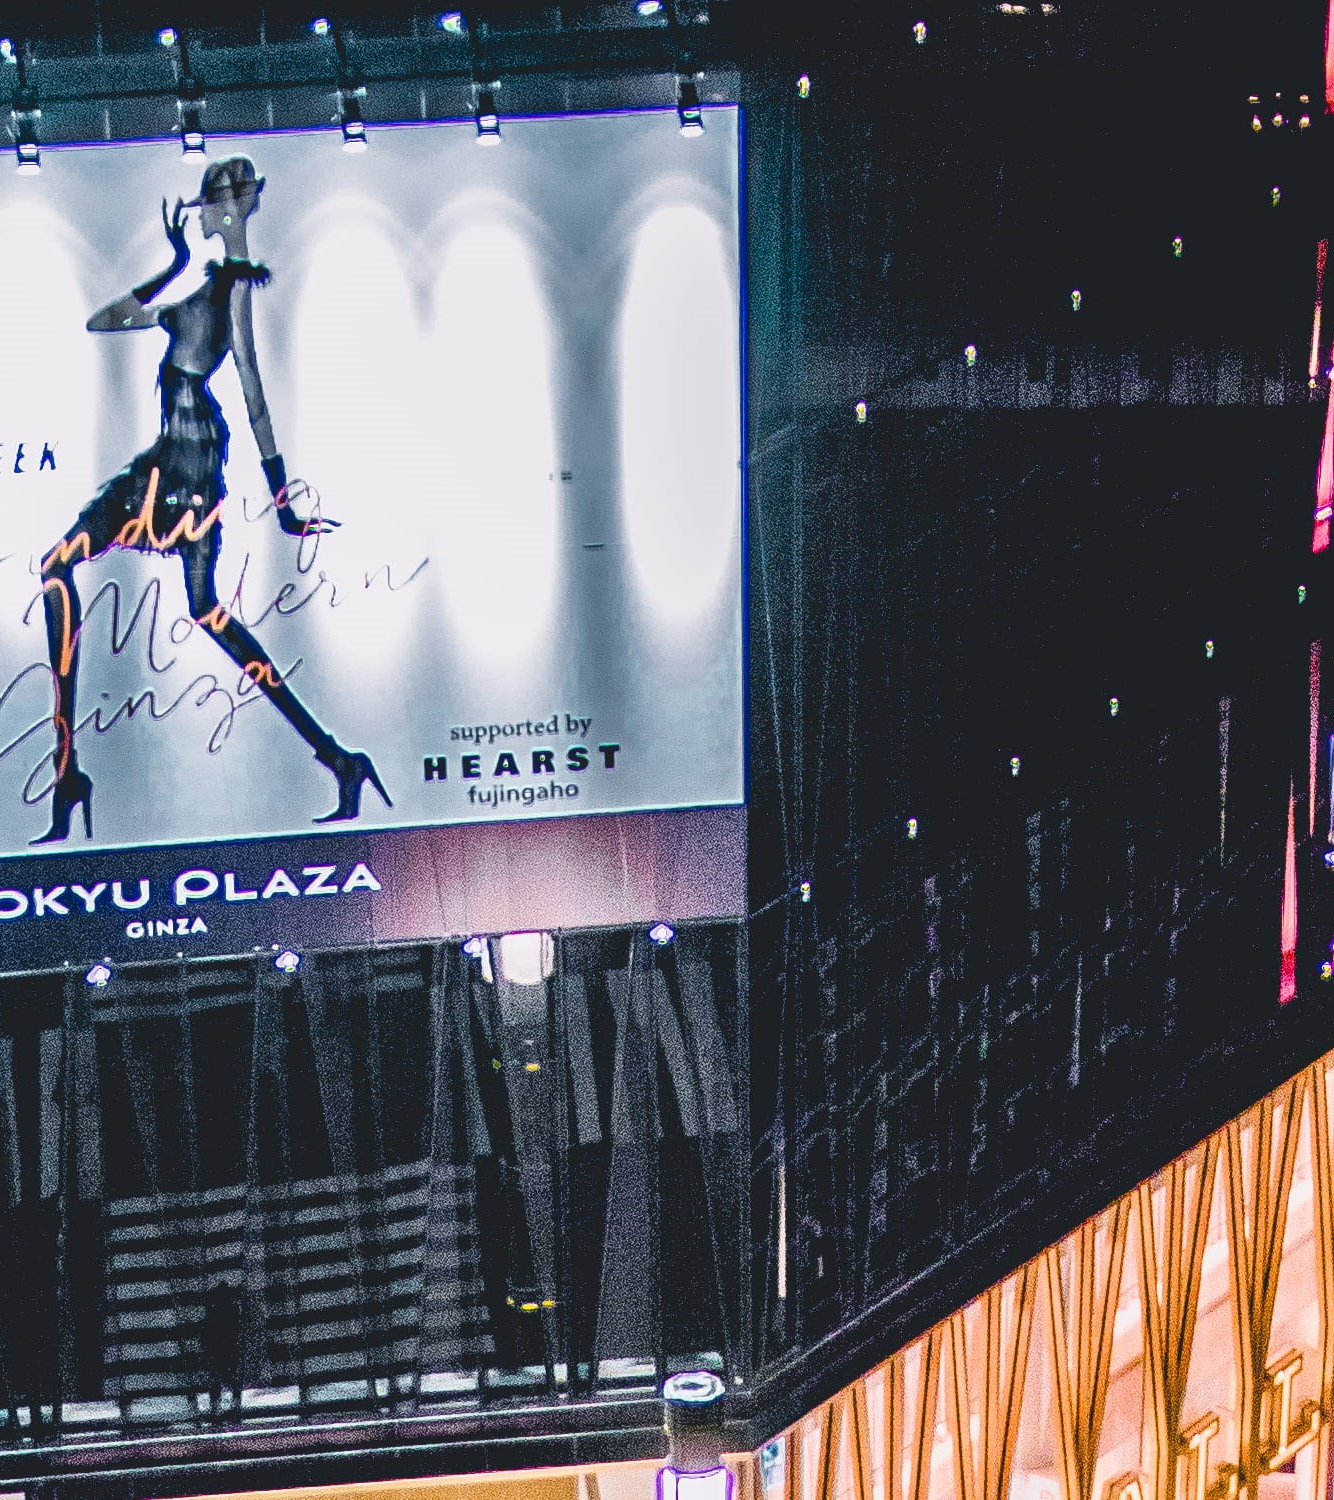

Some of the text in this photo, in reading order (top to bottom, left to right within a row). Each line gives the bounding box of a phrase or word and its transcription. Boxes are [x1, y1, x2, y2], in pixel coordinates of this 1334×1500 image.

[23, 553, 430, 675] Modern
[450, 713, 593, 745] supported by
[423, 742, 621, 783] HEARST
[467, 780, 580, 809] fujingaho
[175, 861, 382, 906] PLAZA
[125, 916, 208, 939] GINZA
